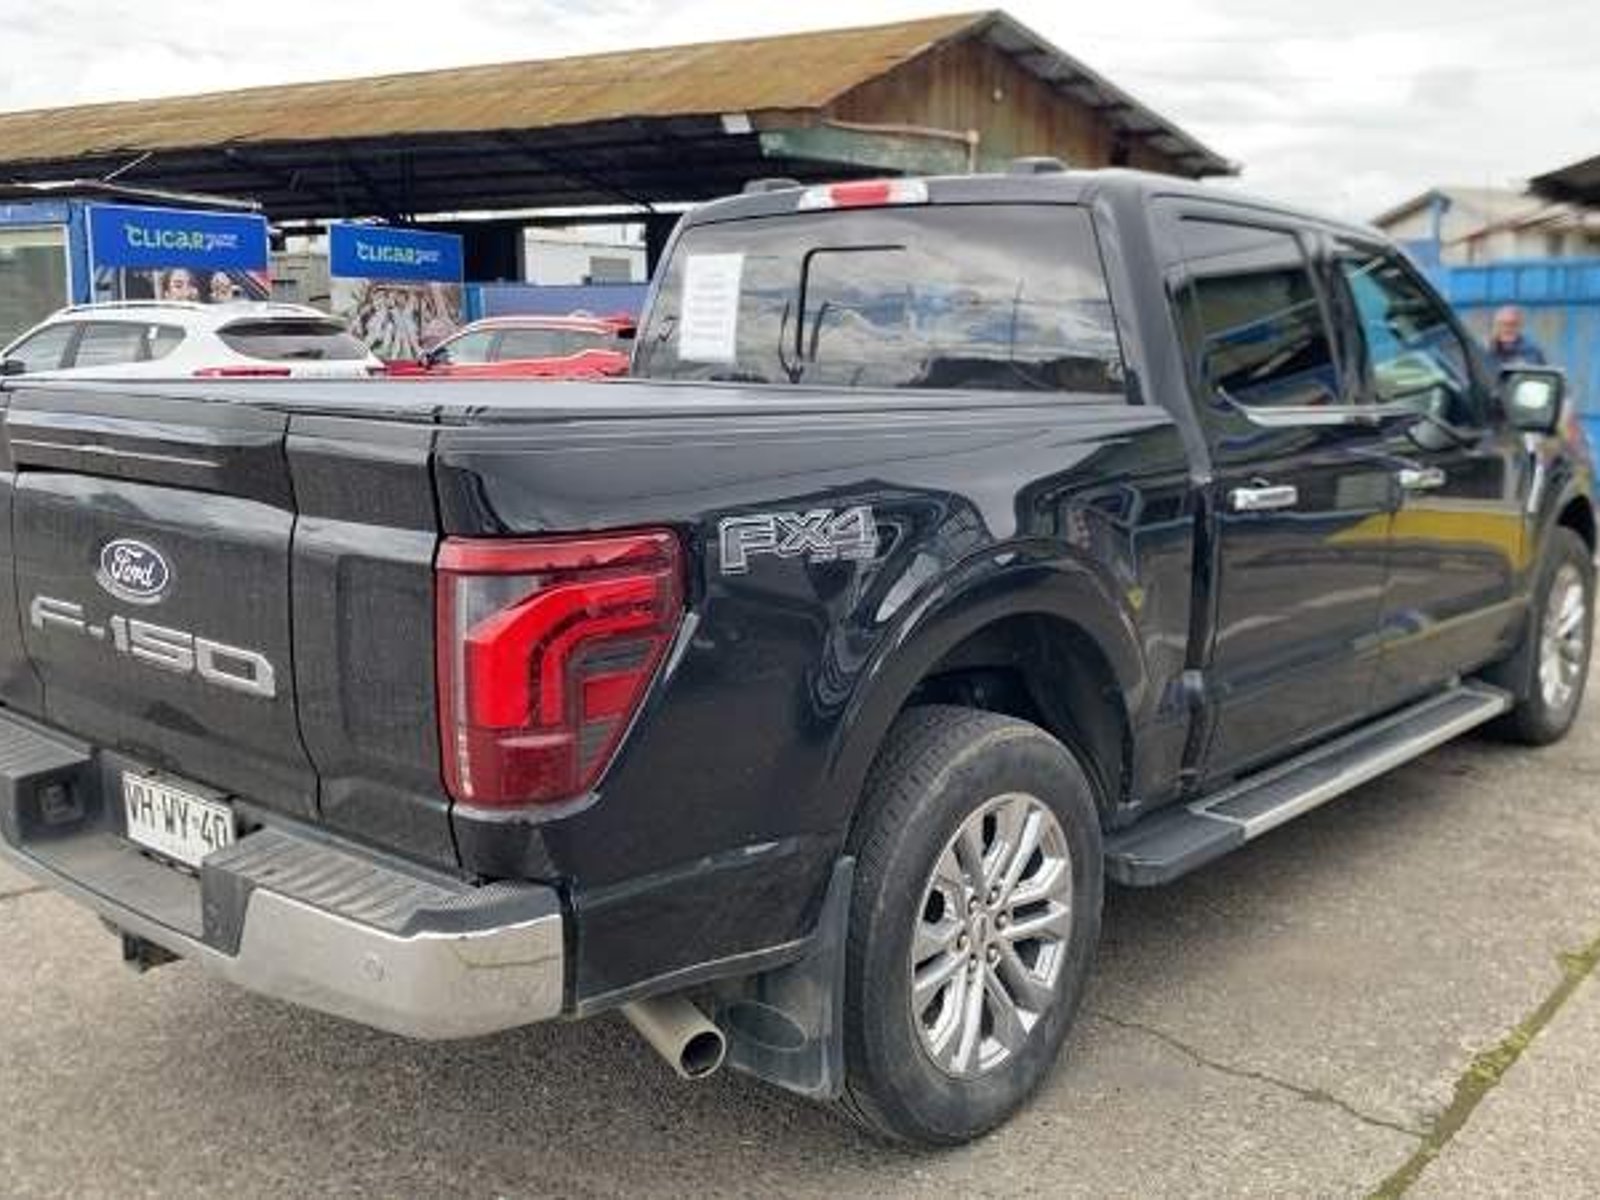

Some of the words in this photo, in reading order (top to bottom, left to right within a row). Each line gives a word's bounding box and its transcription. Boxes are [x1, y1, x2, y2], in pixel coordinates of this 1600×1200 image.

[110, 546, 156, 587] Ford
[718, 506, 878, 575] FX4
[31, 595, 276, 697] F-150
